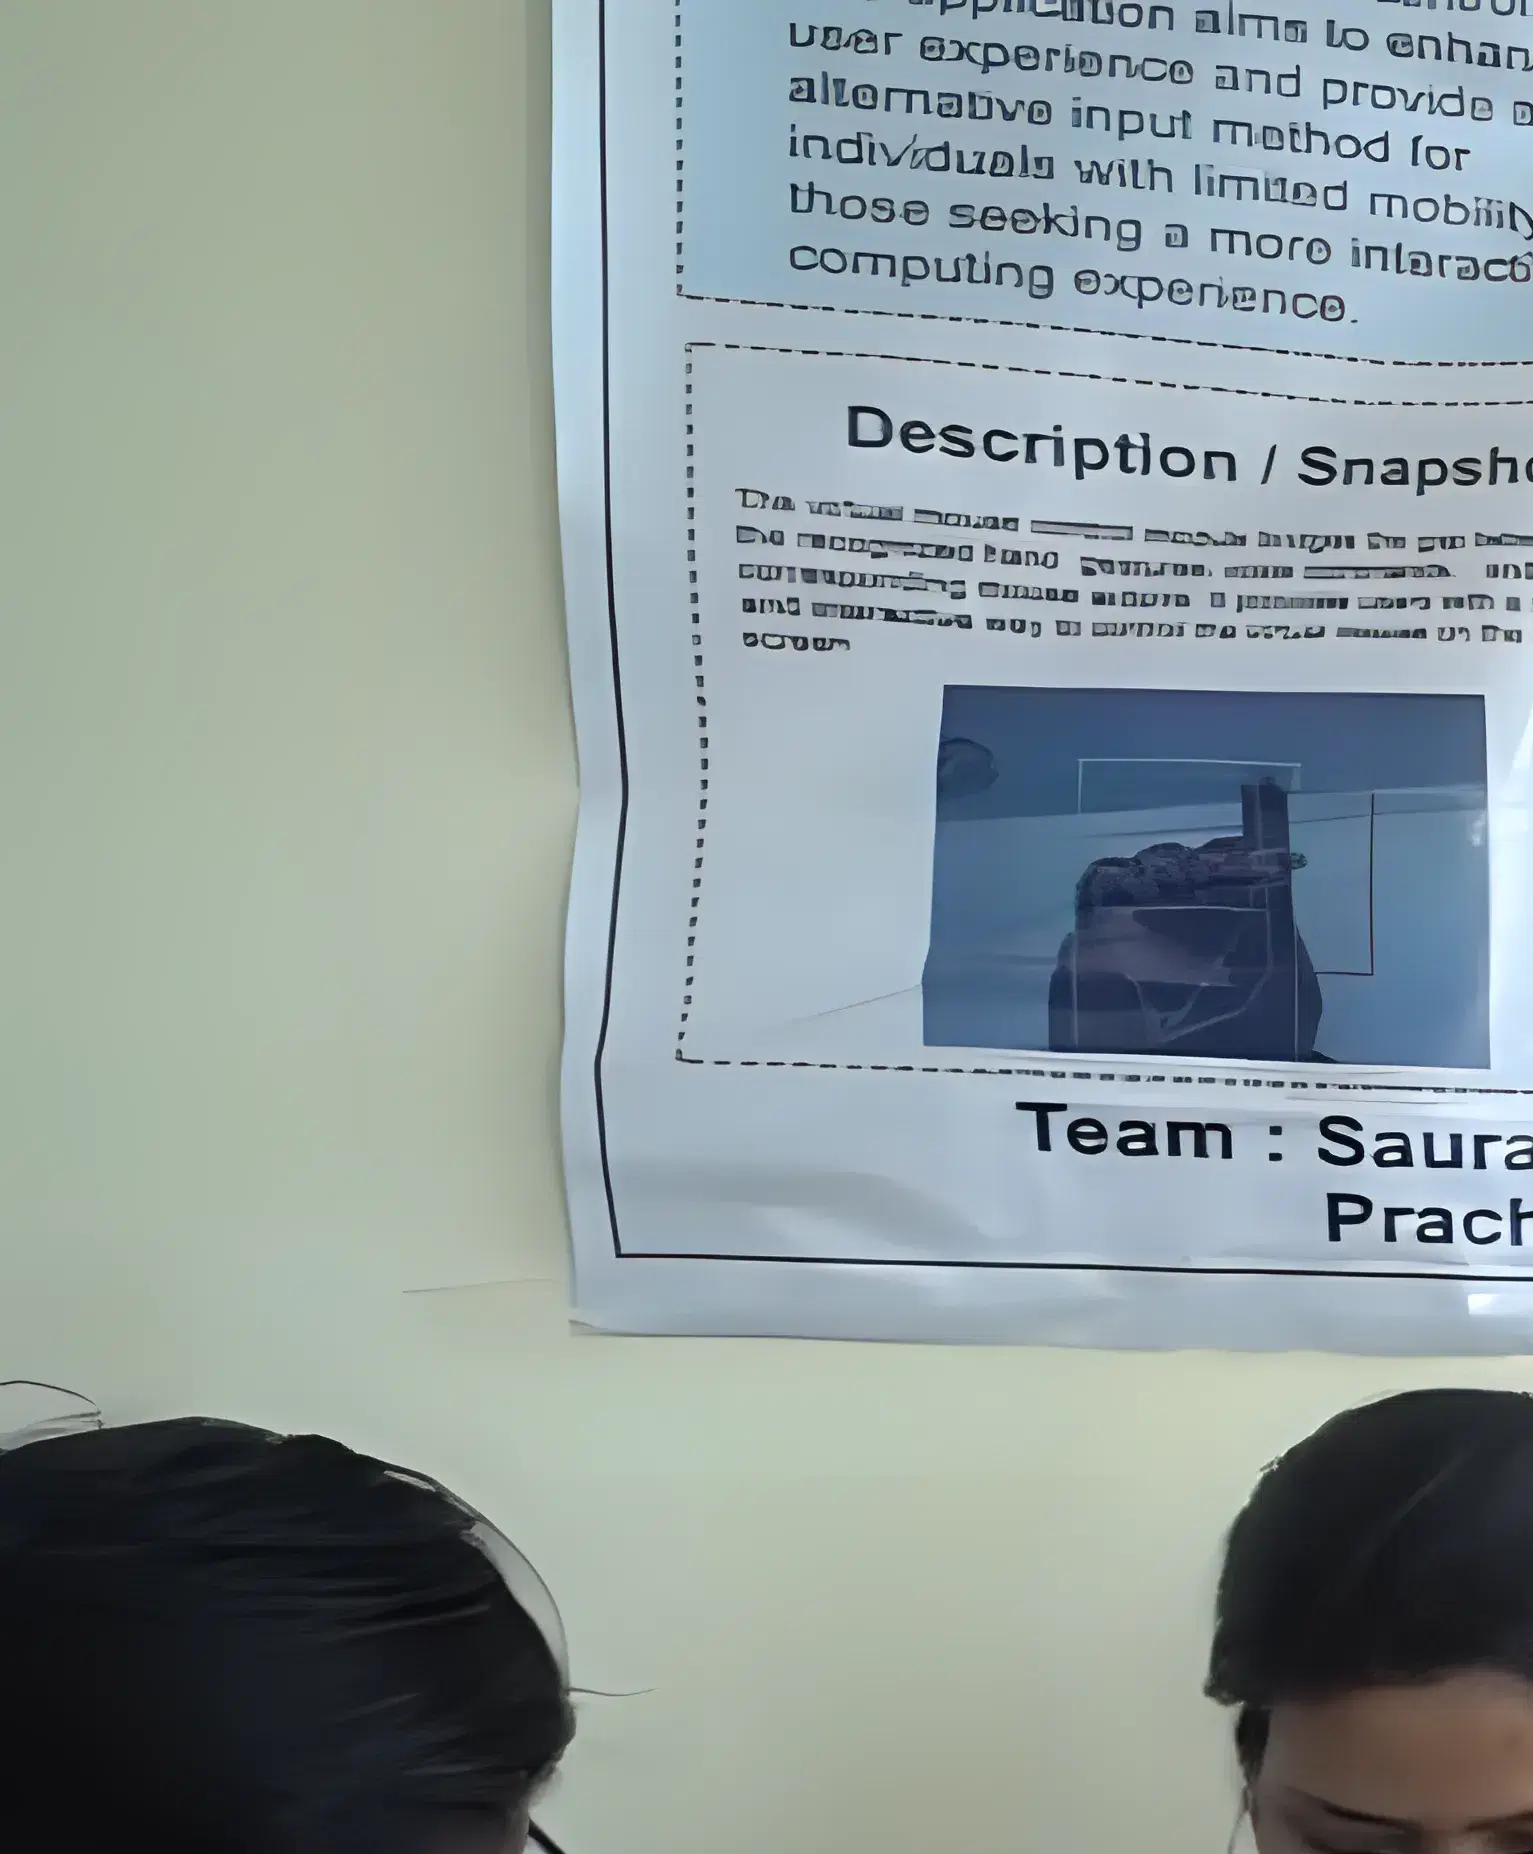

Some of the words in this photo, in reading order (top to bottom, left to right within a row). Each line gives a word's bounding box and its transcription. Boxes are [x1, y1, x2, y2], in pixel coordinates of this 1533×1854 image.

[847, 405, 1237, 481] Description
[1261, 444, 1277, 485] /
[1015, 1101, 1233, 1159] Team
[1269, 1124, 1283, 1162] :
